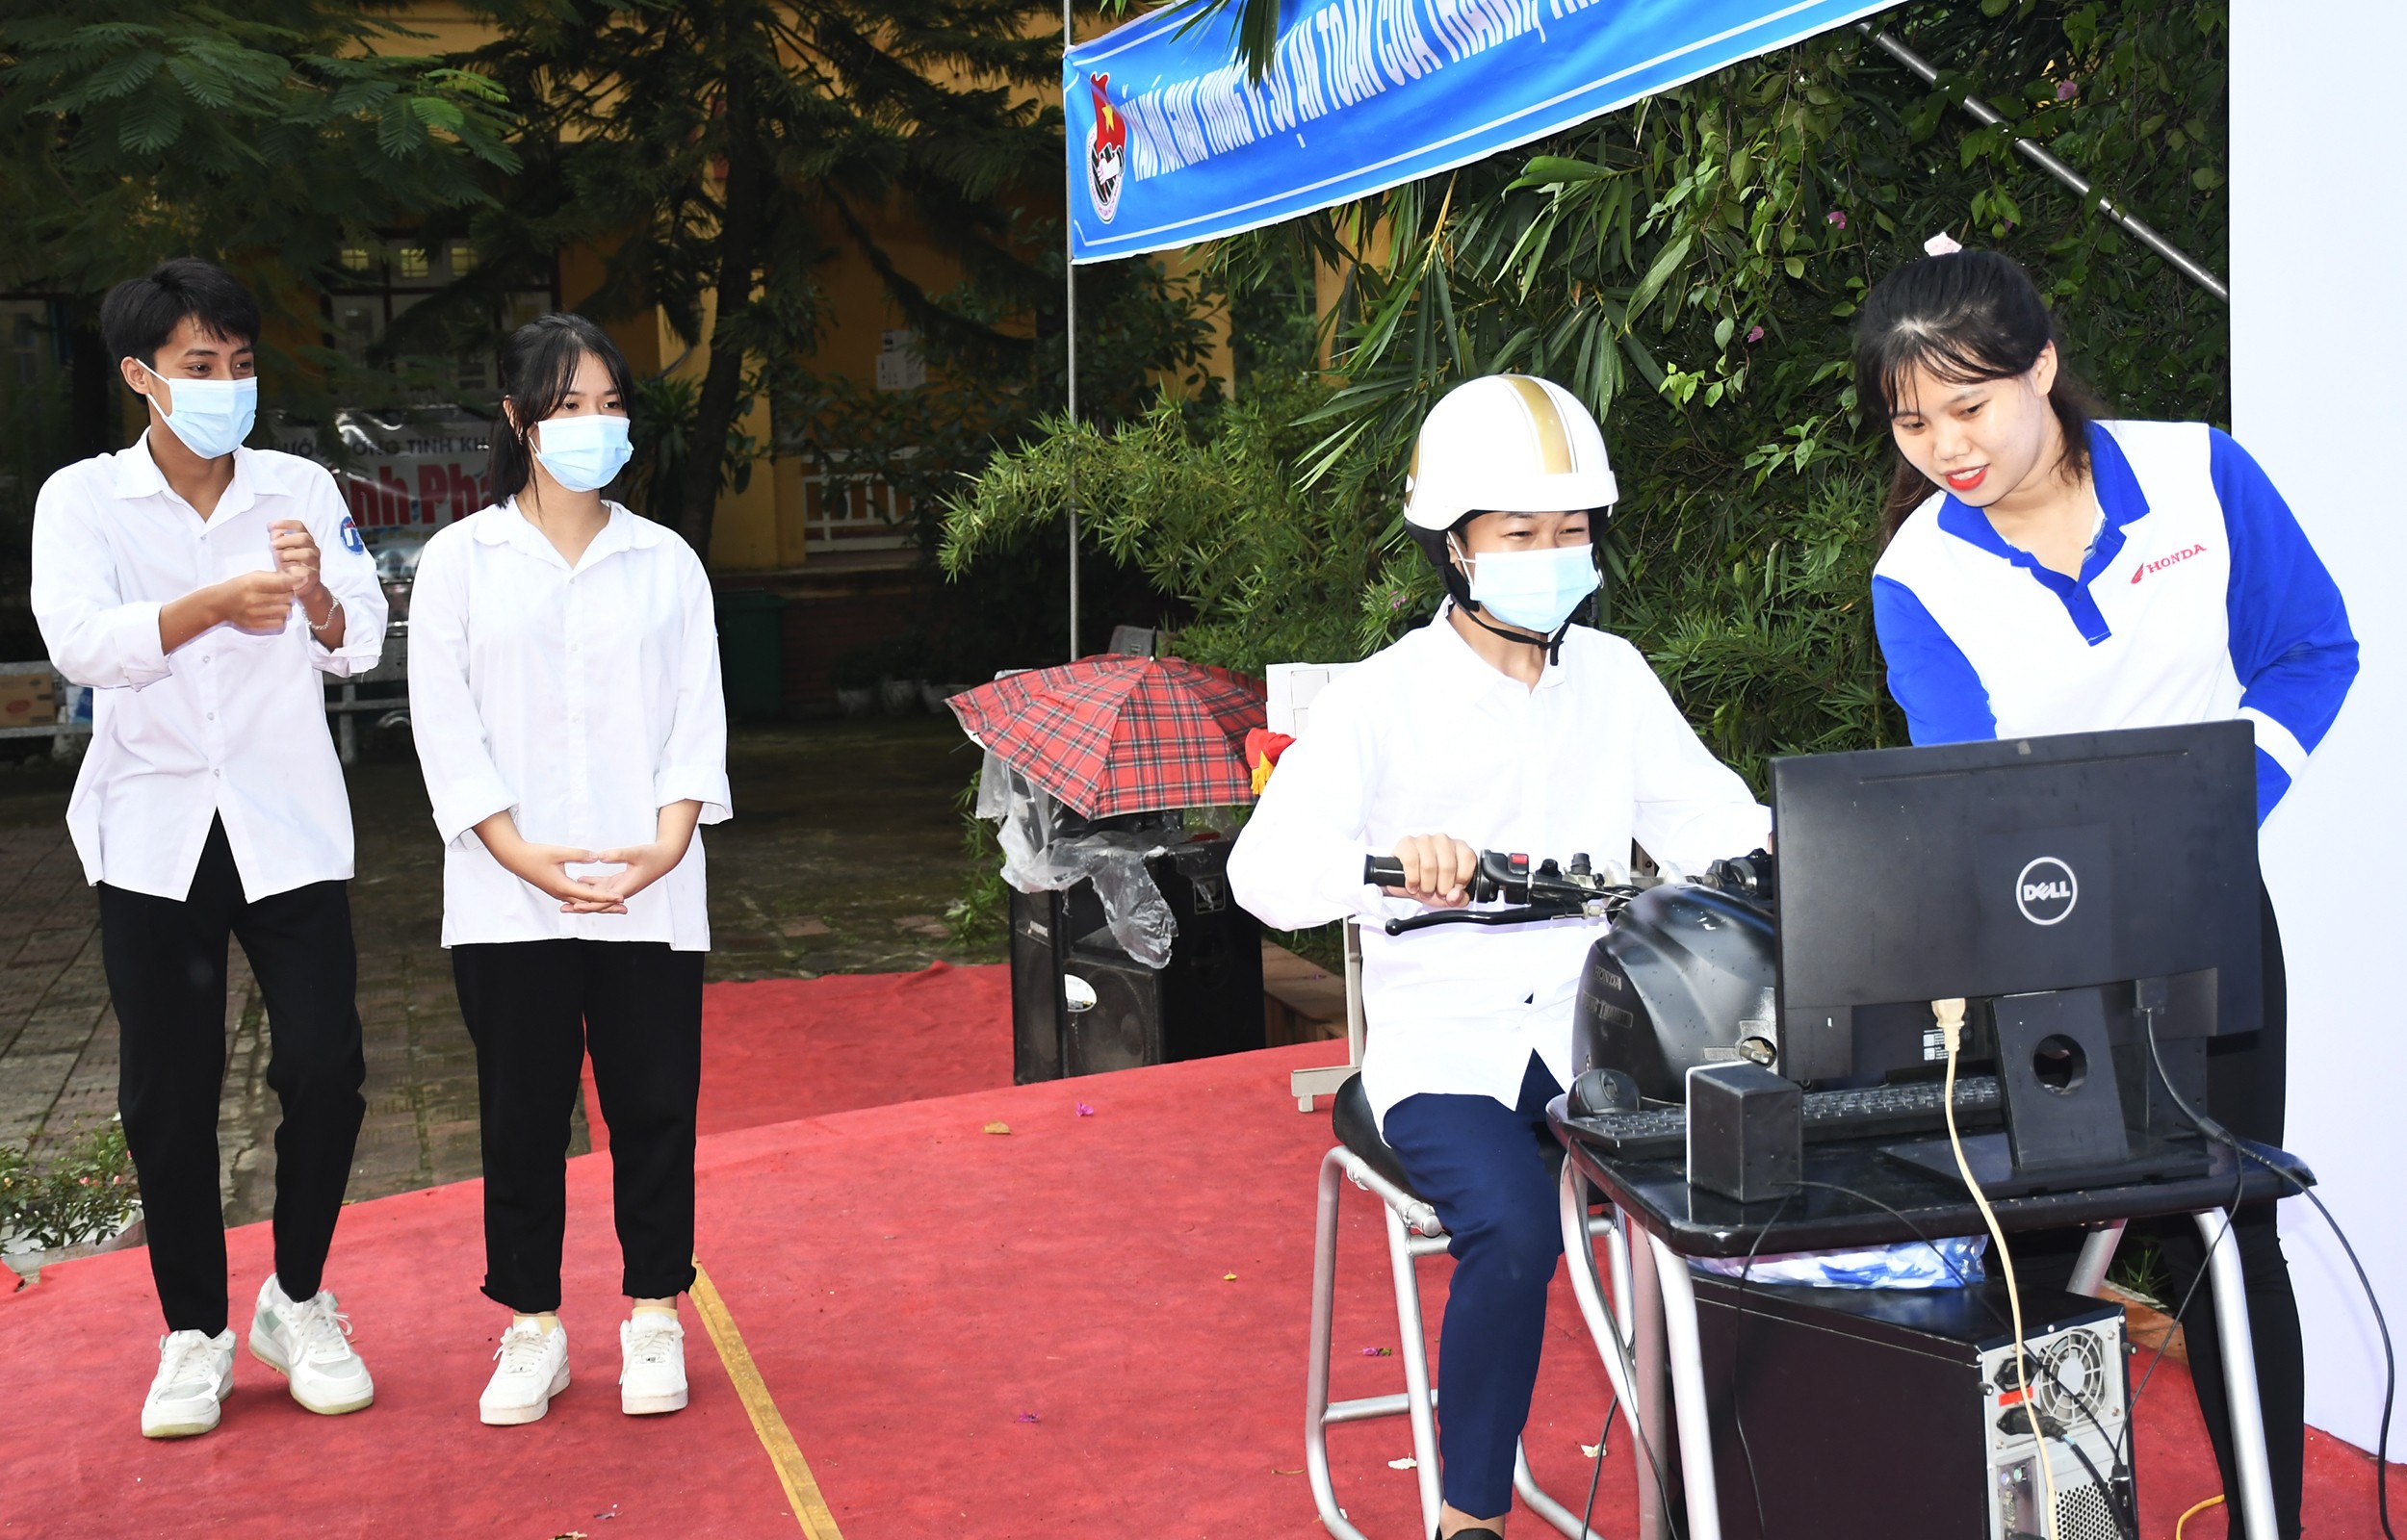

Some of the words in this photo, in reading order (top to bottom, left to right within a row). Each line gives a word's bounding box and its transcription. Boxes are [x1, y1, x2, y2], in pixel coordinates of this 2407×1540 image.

[1163, 75, 1209, 167] GIAO
[407, 438, 453, 456] TINH
[460, 437, 490, 452] KH
[337, 465, 411, 526] nh
[2145, 544, 2208, 573] HONDA
[2023, 880, 2071, 901] DELL
[1593, 964, 1622, 991] HONDA
